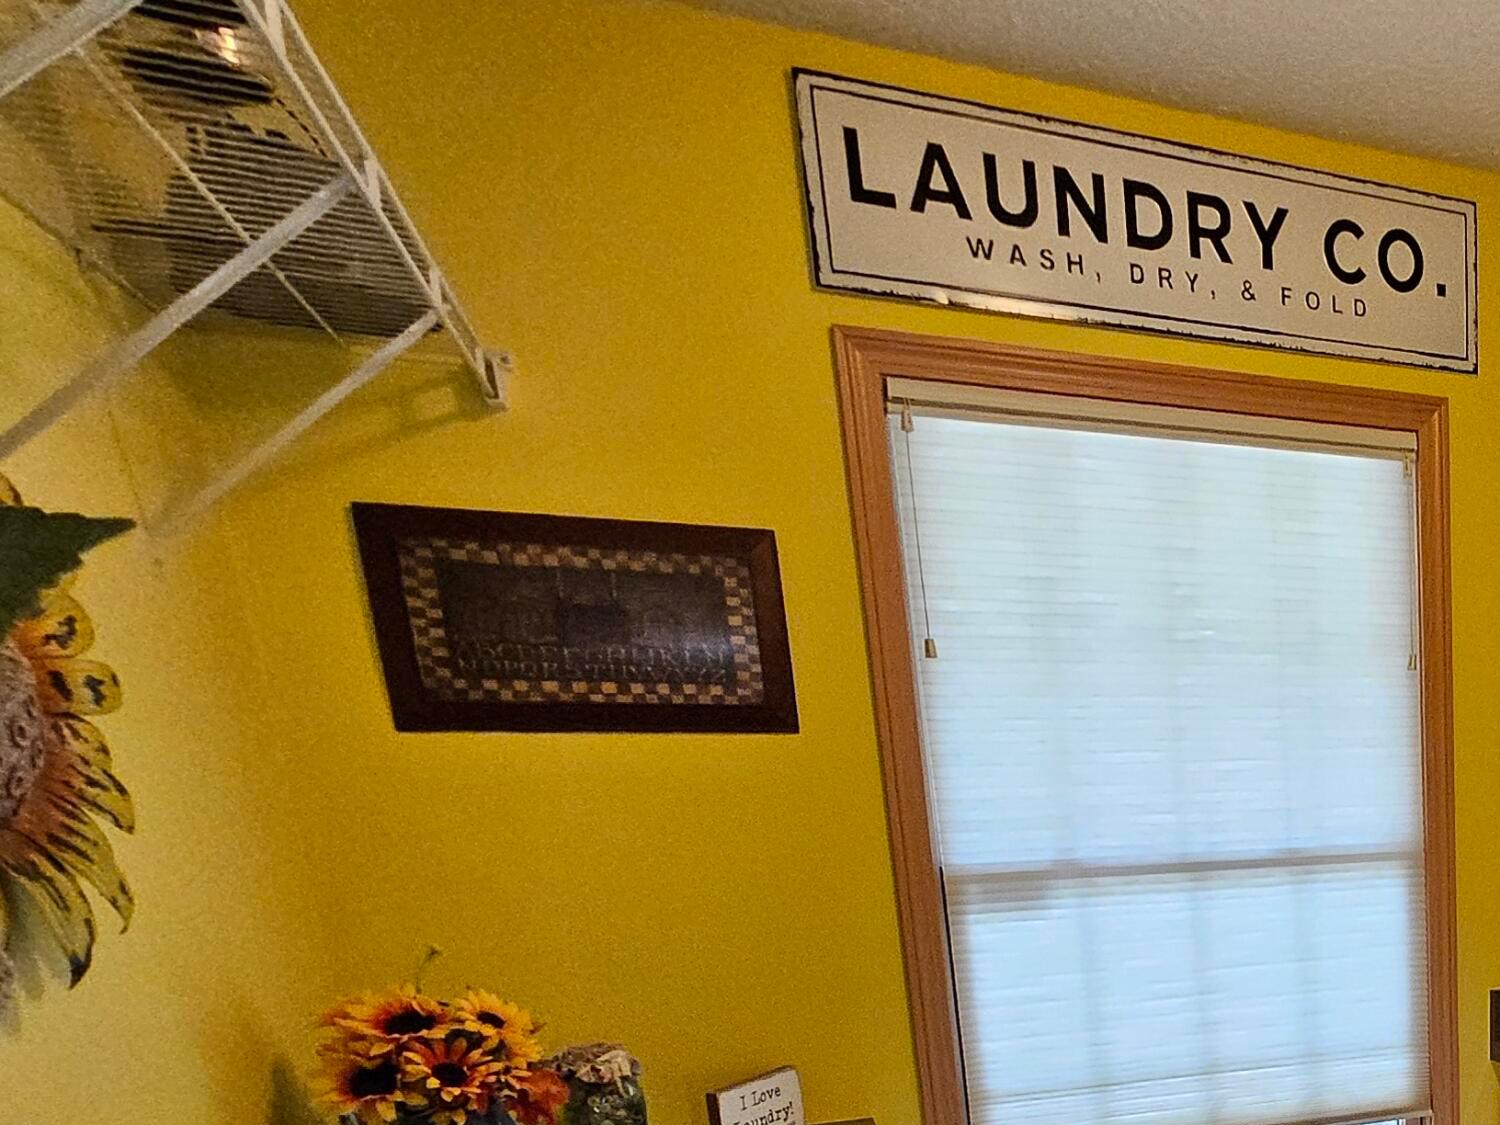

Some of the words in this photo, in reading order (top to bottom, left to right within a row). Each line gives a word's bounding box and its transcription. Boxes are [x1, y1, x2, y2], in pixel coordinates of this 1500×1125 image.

[842, 127, 1289, 270] LAUNDRY
[1324, 219, 1448, 297] CO.
[966, 236, 1102, 283] WASH,
[1130, 263, 1217, 299] DRY,
[1241, 280, 1256, 301] &
[1281, 286, 1368, 317] FOLD
[740, 1095, 748, 1111] I
[752, 1086, 781, 1106] Love
